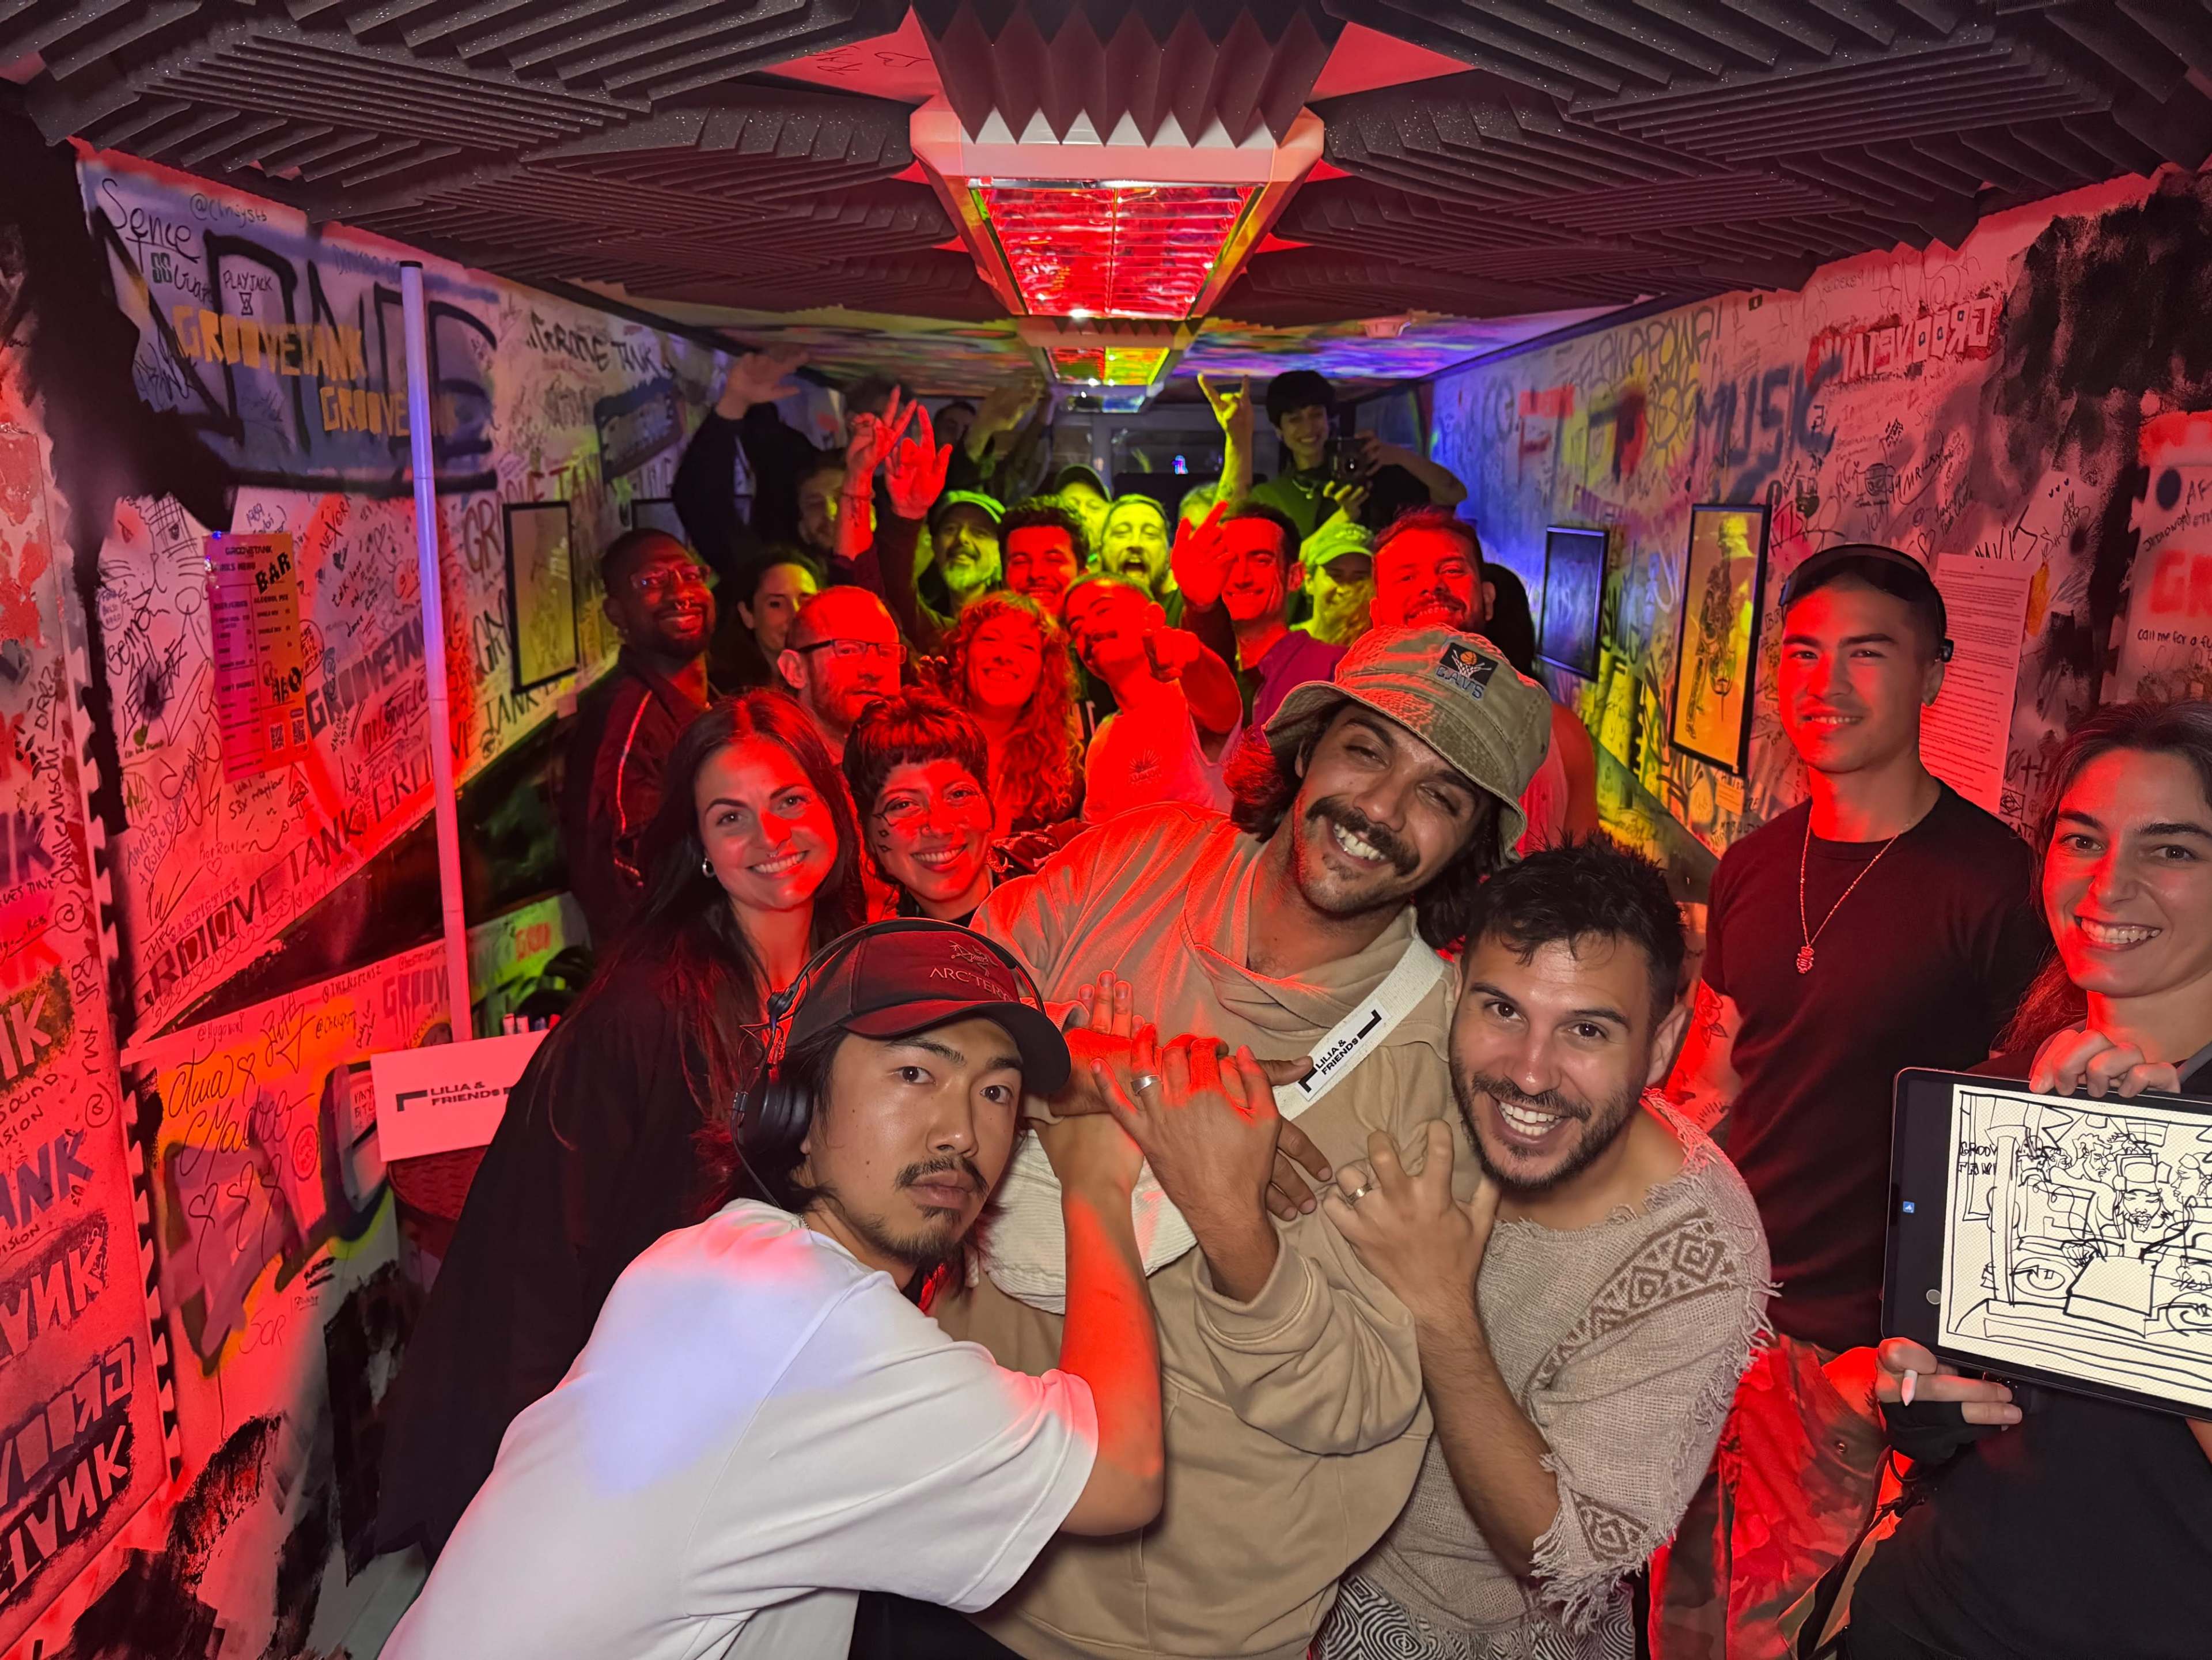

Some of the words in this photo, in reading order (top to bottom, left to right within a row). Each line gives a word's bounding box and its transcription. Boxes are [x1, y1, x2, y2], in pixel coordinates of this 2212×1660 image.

[255, 551, 291, 595] BAR
[1437, 665, 1484, 699] CAVS
[1315, 1047, 1339, 1069] LILIA
[1338, 1039, 1346, 1048] &
[1321, 1038, 1359, 1075] FRIENDS
[430, 1083, 471, 1096] LILIA
[474, 1081, 486, 1090] &
[431, 1089, 500, 1106] FRIENDS
